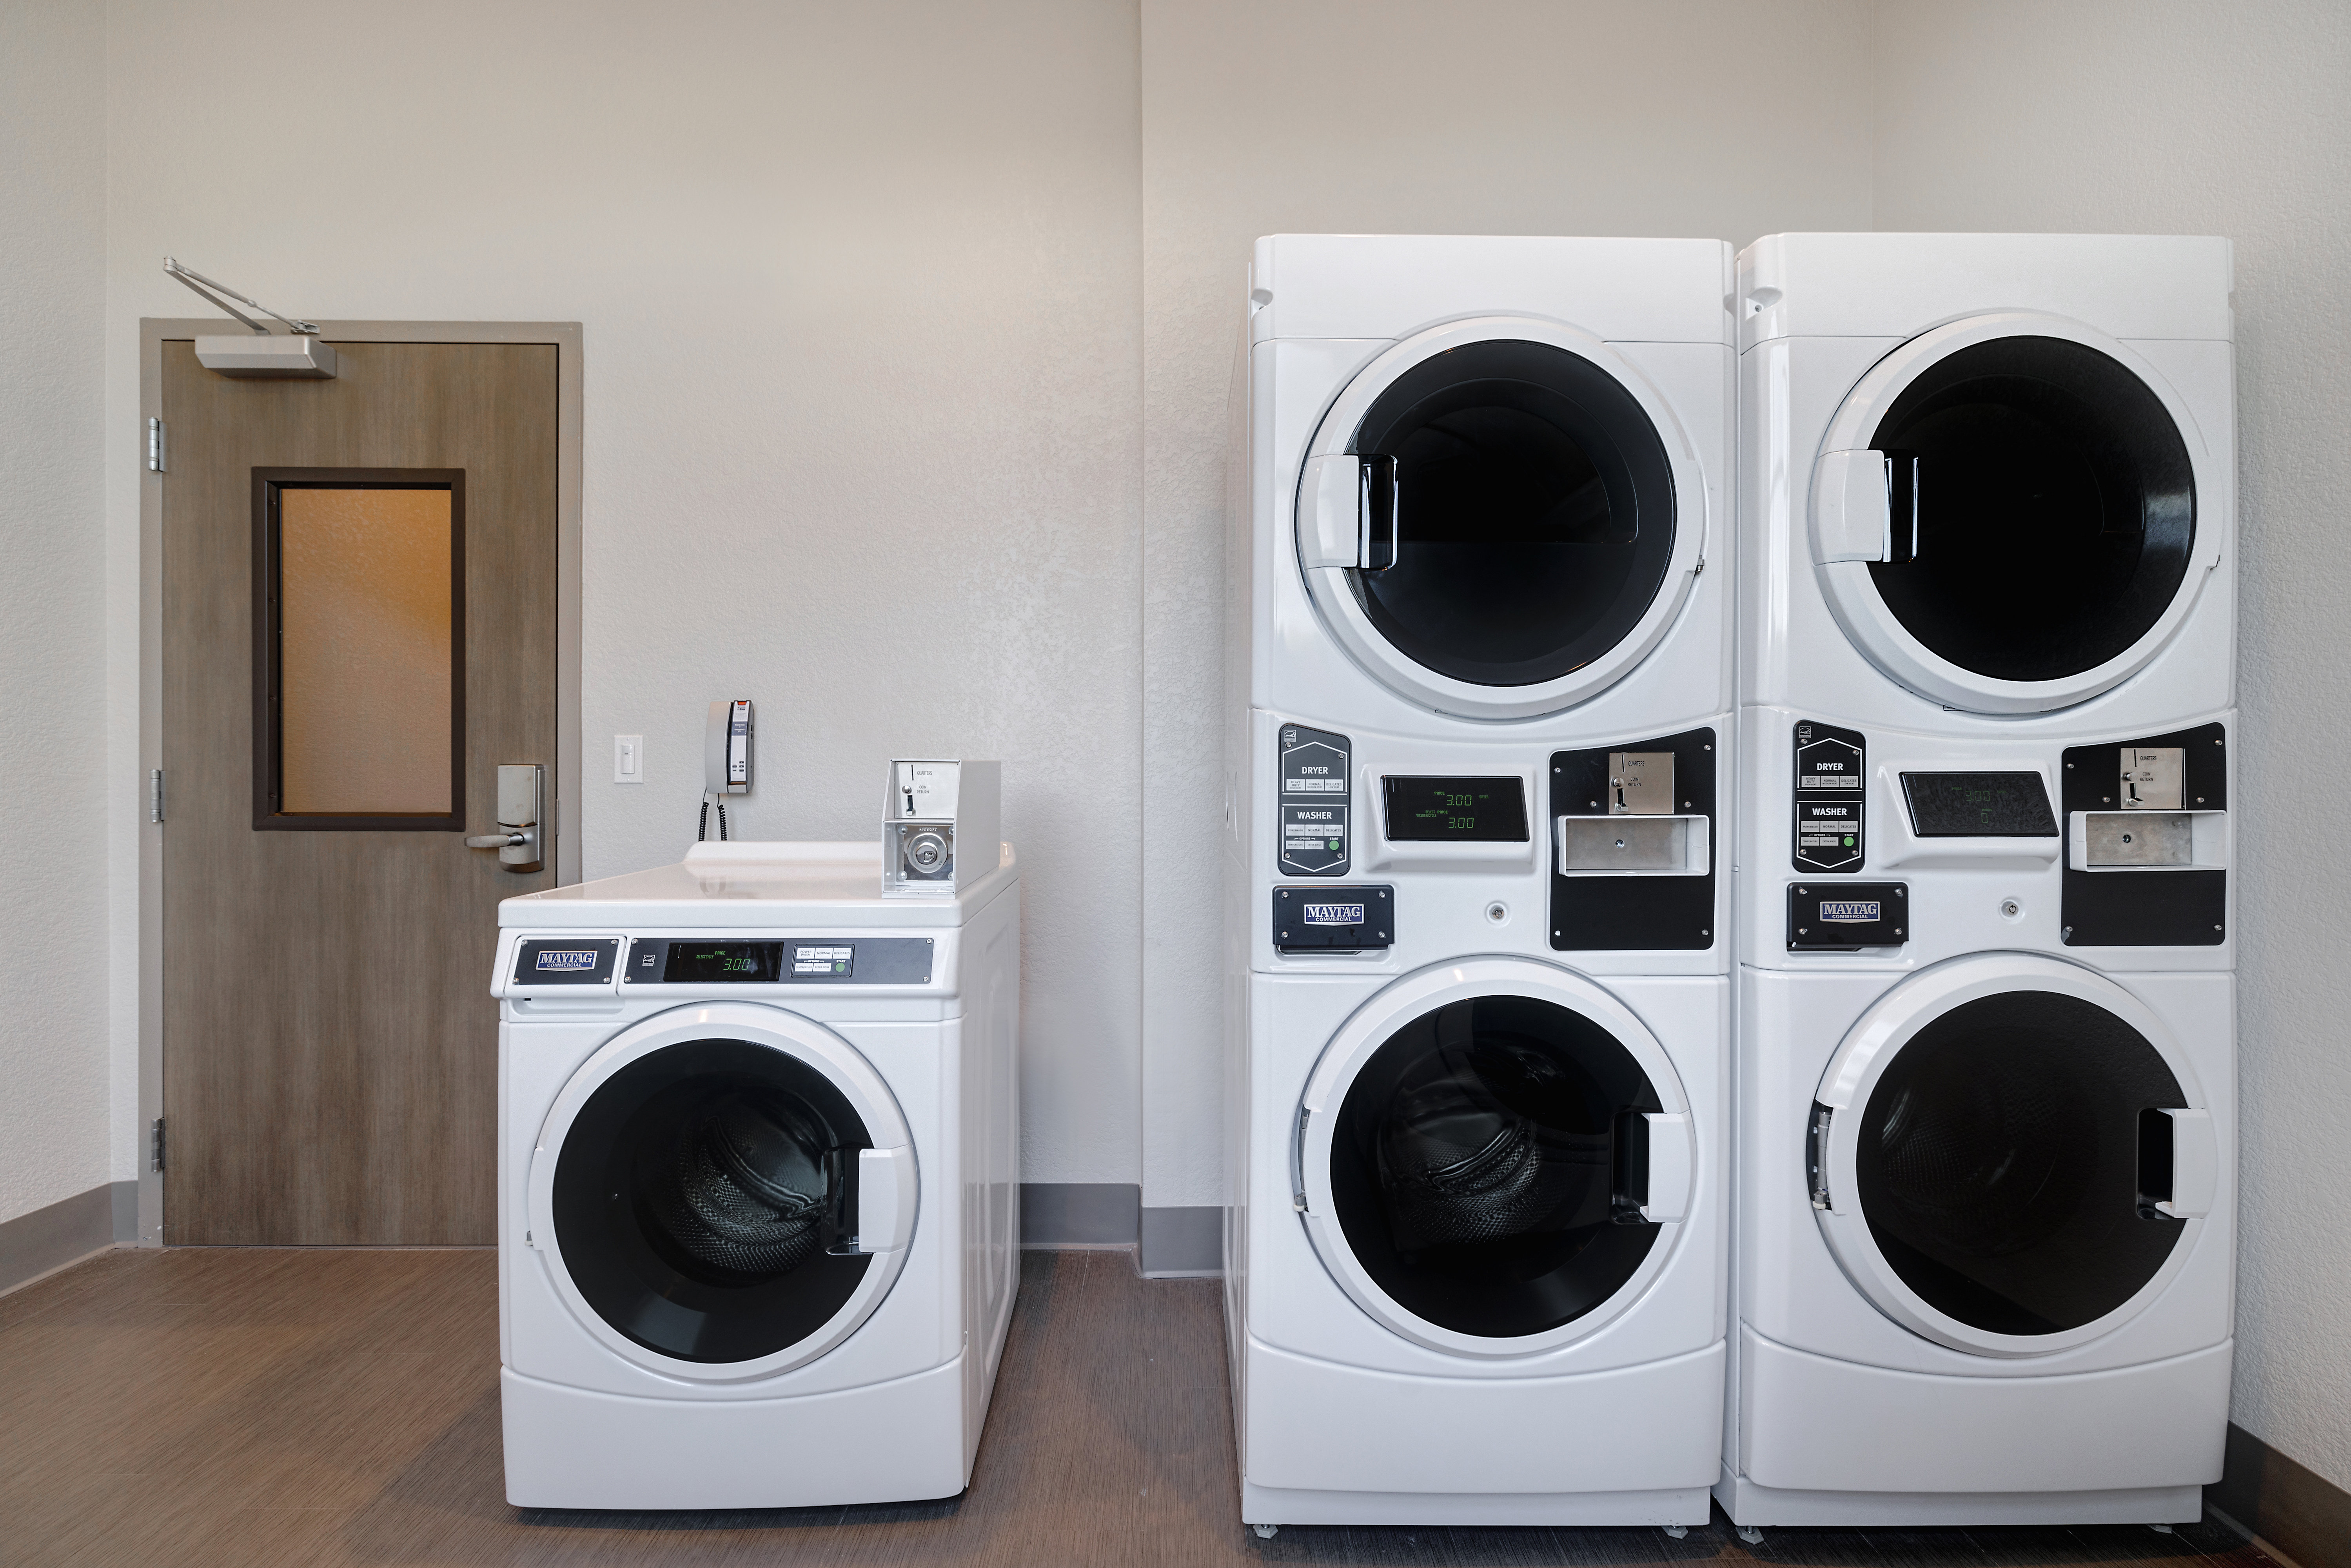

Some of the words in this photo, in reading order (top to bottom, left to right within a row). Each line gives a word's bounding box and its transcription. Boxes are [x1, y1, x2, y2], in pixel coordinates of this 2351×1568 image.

[1447, 795, 1472, 806] 3.00
[1965, 791, 1990, 801] 3.00
[1449, 817, 1474, 828] 3.00
[1981, 813, 1988, 823] 0
[1307, 907, 1361, 917] MAYTAG
[1824, 904, 1877, 914] MAYTAG
[540, 953, 592, 963] MAYTAG
[723, 959, 750, 970] 3.00
